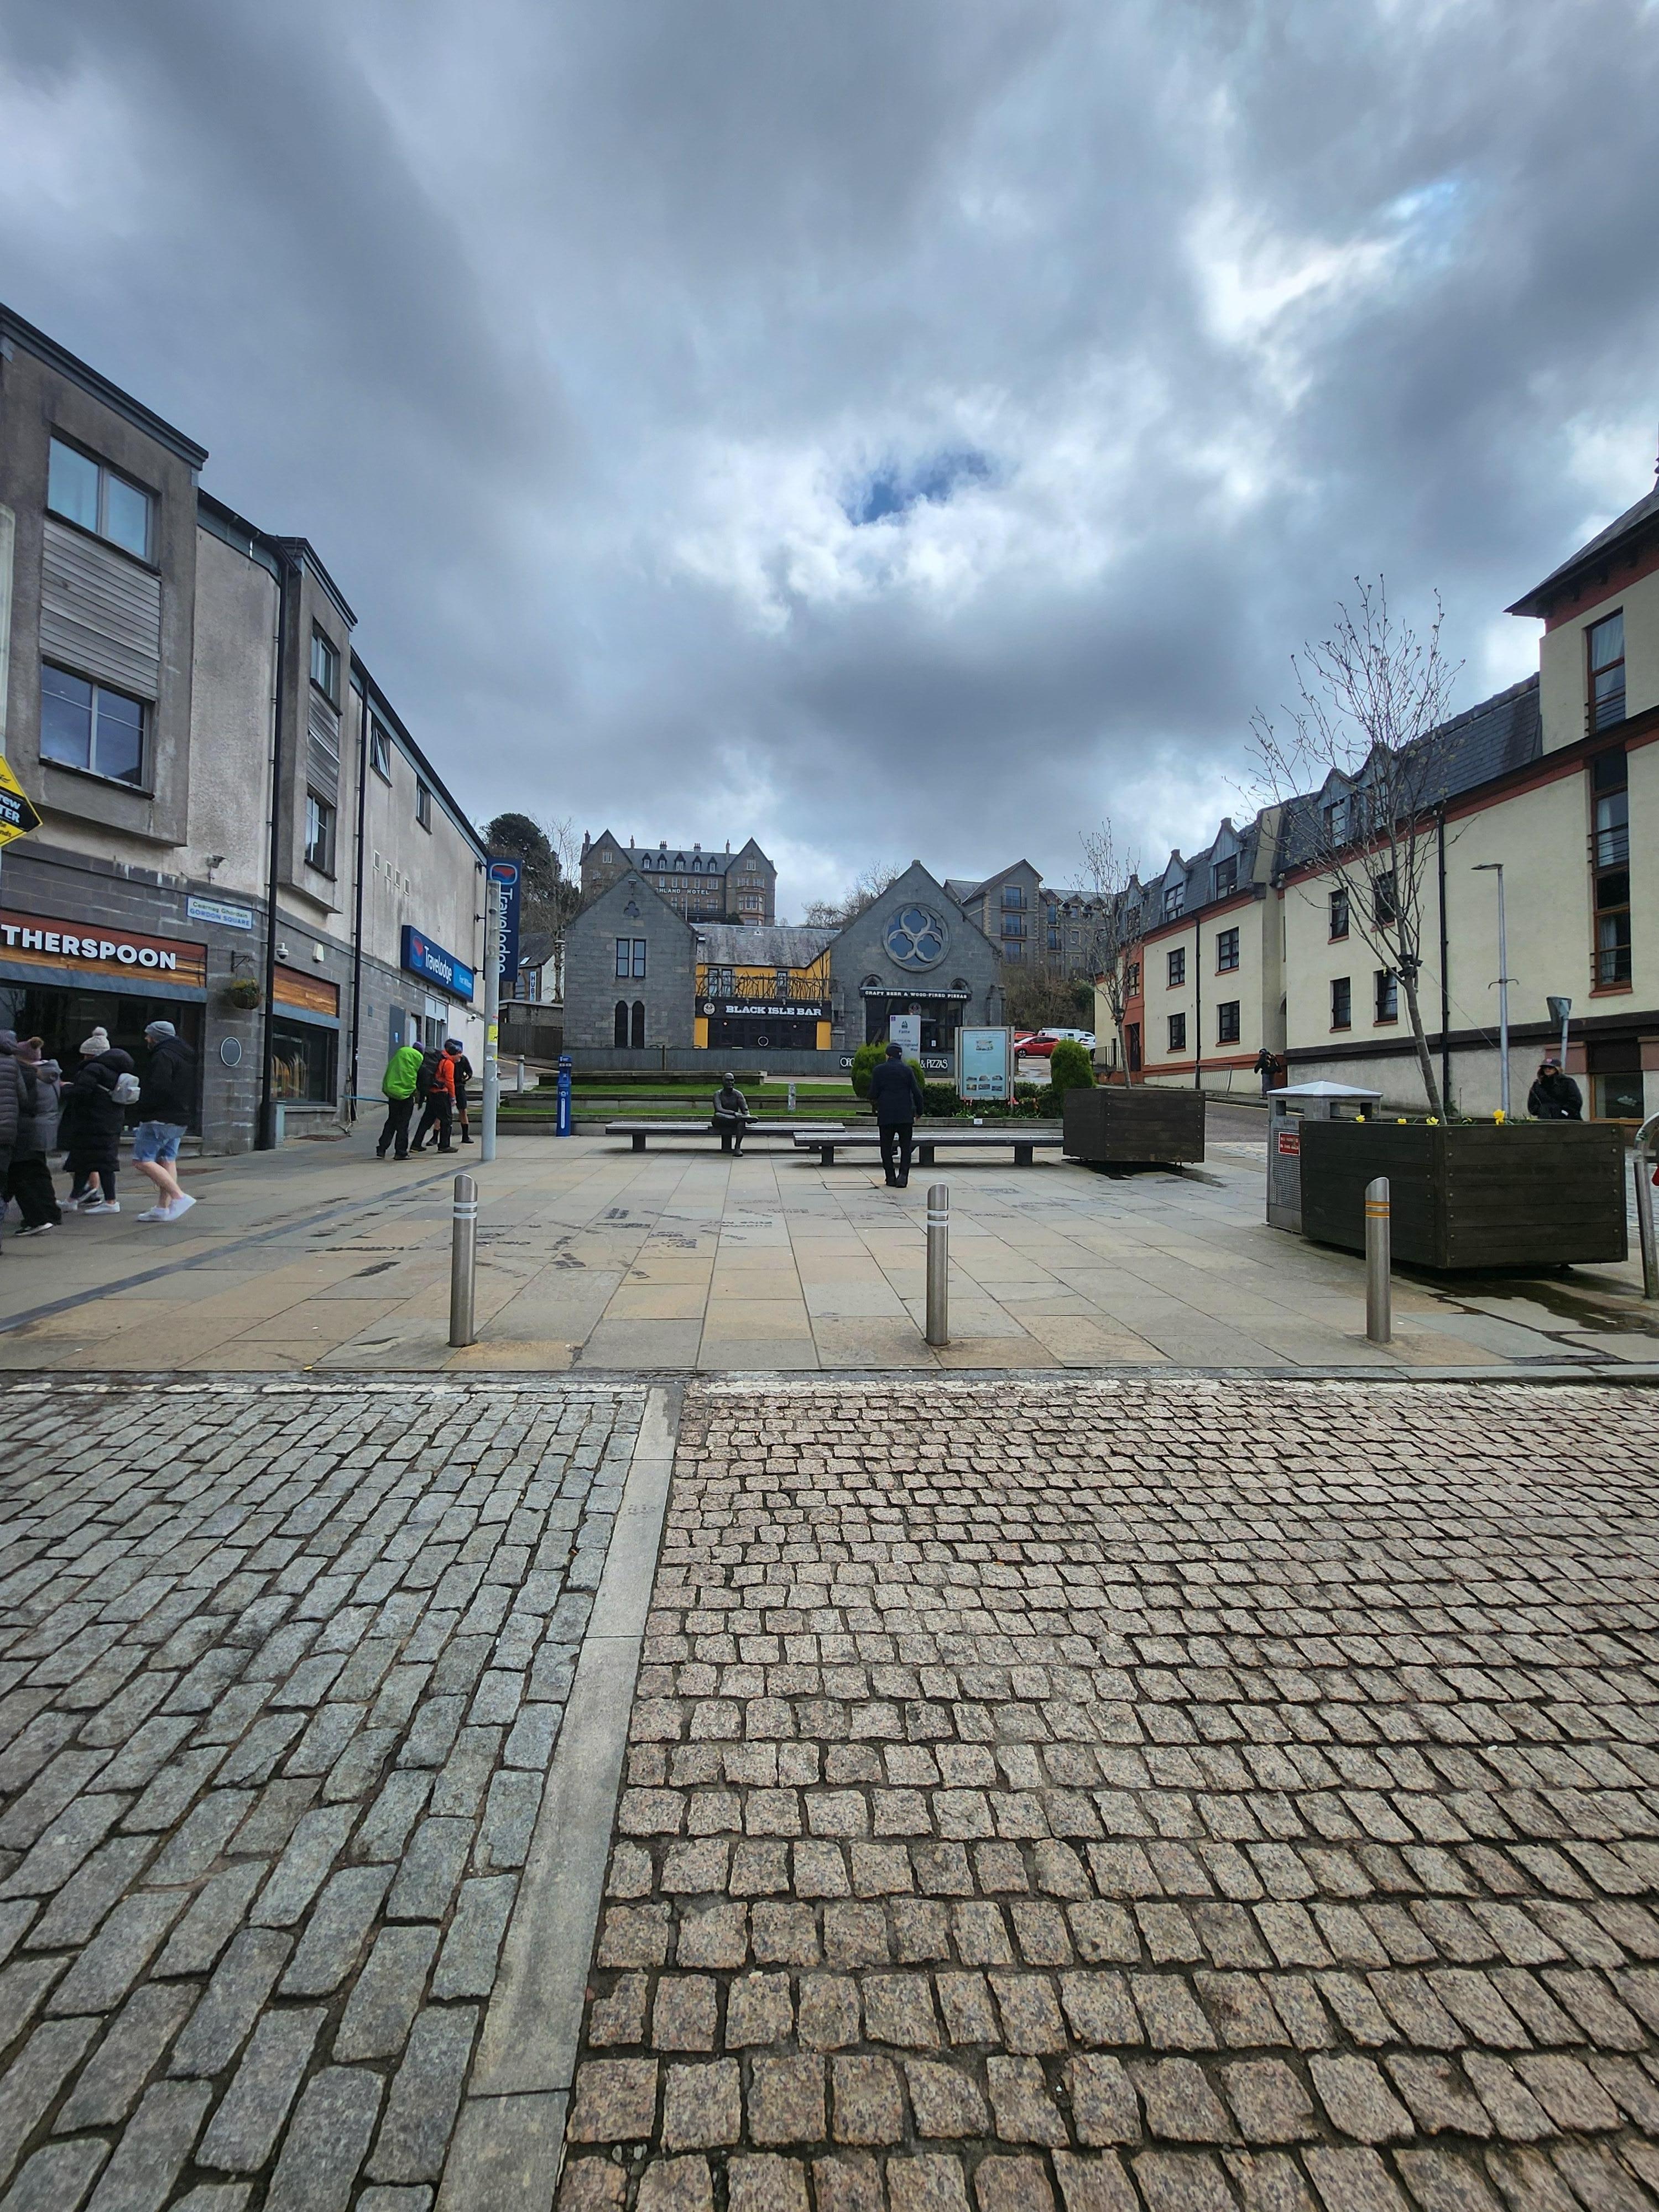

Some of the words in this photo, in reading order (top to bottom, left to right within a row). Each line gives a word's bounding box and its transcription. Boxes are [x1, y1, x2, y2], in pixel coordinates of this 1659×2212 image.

[190, 908, 221, 920] GORDON
[223, 916, 250, 926] SQUARE
[1, 924, 176, 969] THERSPOON
[424, 945, 452, 984] Travelodge
[726, 1005, 766, 1014] BLACK
[768, 1006, 795, 1015] ISLE
[796, 1008, 822, 1016] BAR
[920, 1059, 926, 1068] &
[926, 1058, 948, 1069] PIZZAS
